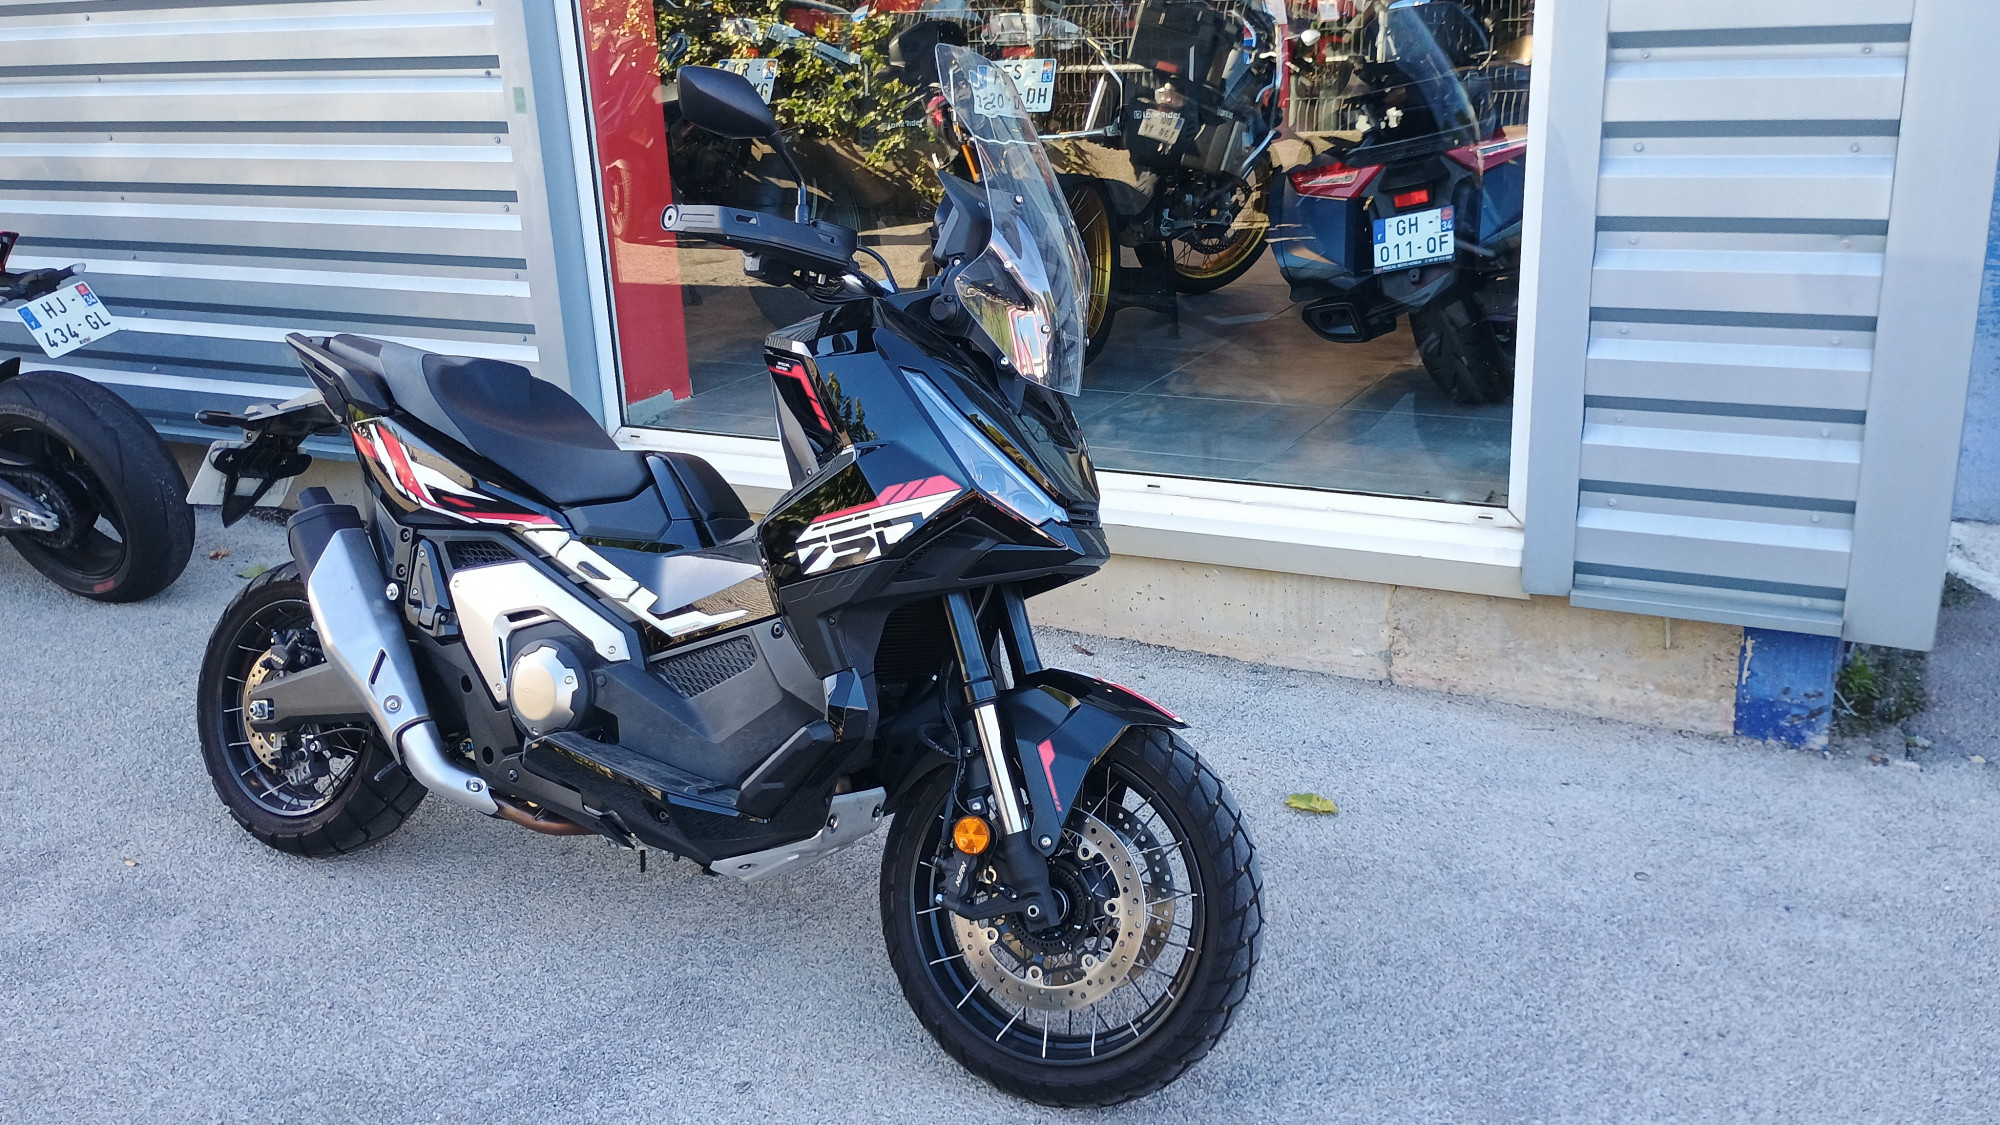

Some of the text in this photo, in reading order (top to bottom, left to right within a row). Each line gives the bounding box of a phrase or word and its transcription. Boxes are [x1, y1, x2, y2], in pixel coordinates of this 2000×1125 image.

[1396, 216, 1418, 236] GH
[1441, 221, 1452, 230] 34
[40, 297, 67, 319] HJ
[84, 295, 97, 305] 34
[45, 312, 111, 348] 434-GL
